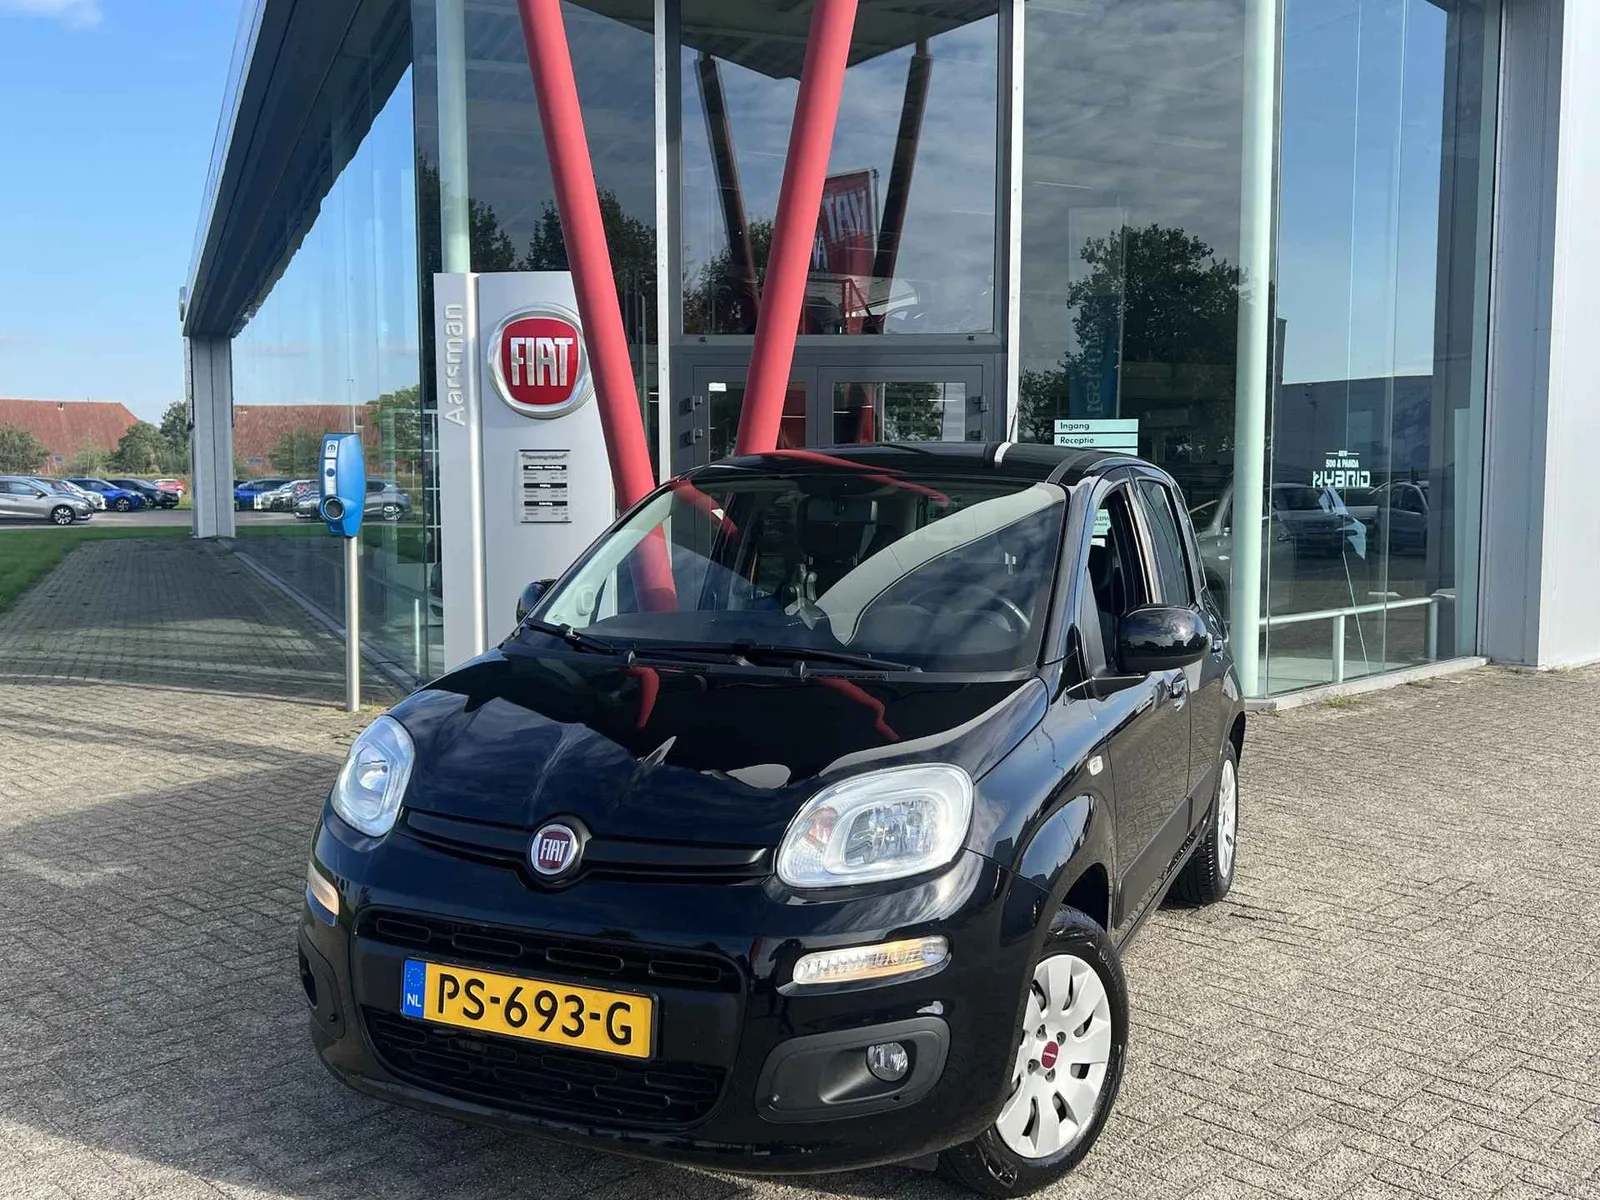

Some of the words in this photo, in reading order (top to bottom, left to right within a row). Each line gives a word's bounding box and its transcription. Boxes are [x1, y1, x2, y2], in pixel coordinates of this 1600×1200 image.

[444, 303, 466, 426] Aarsman
[510, 337, 573, 387] FIAT
[1060, 422, 1090, 431] Ingang
[1060, 436, 1095, 445] Receptie
[1326, 459, 1336, 468] 500
[1342, 459, 1359, 468] PANDA
[1313, 470, 1371, 488] HYBRID
[540, 838, 569, 862] FIAT
[407, 993, 422, 1008] NL
[438, 973, 632, 1046] PS-693-G
